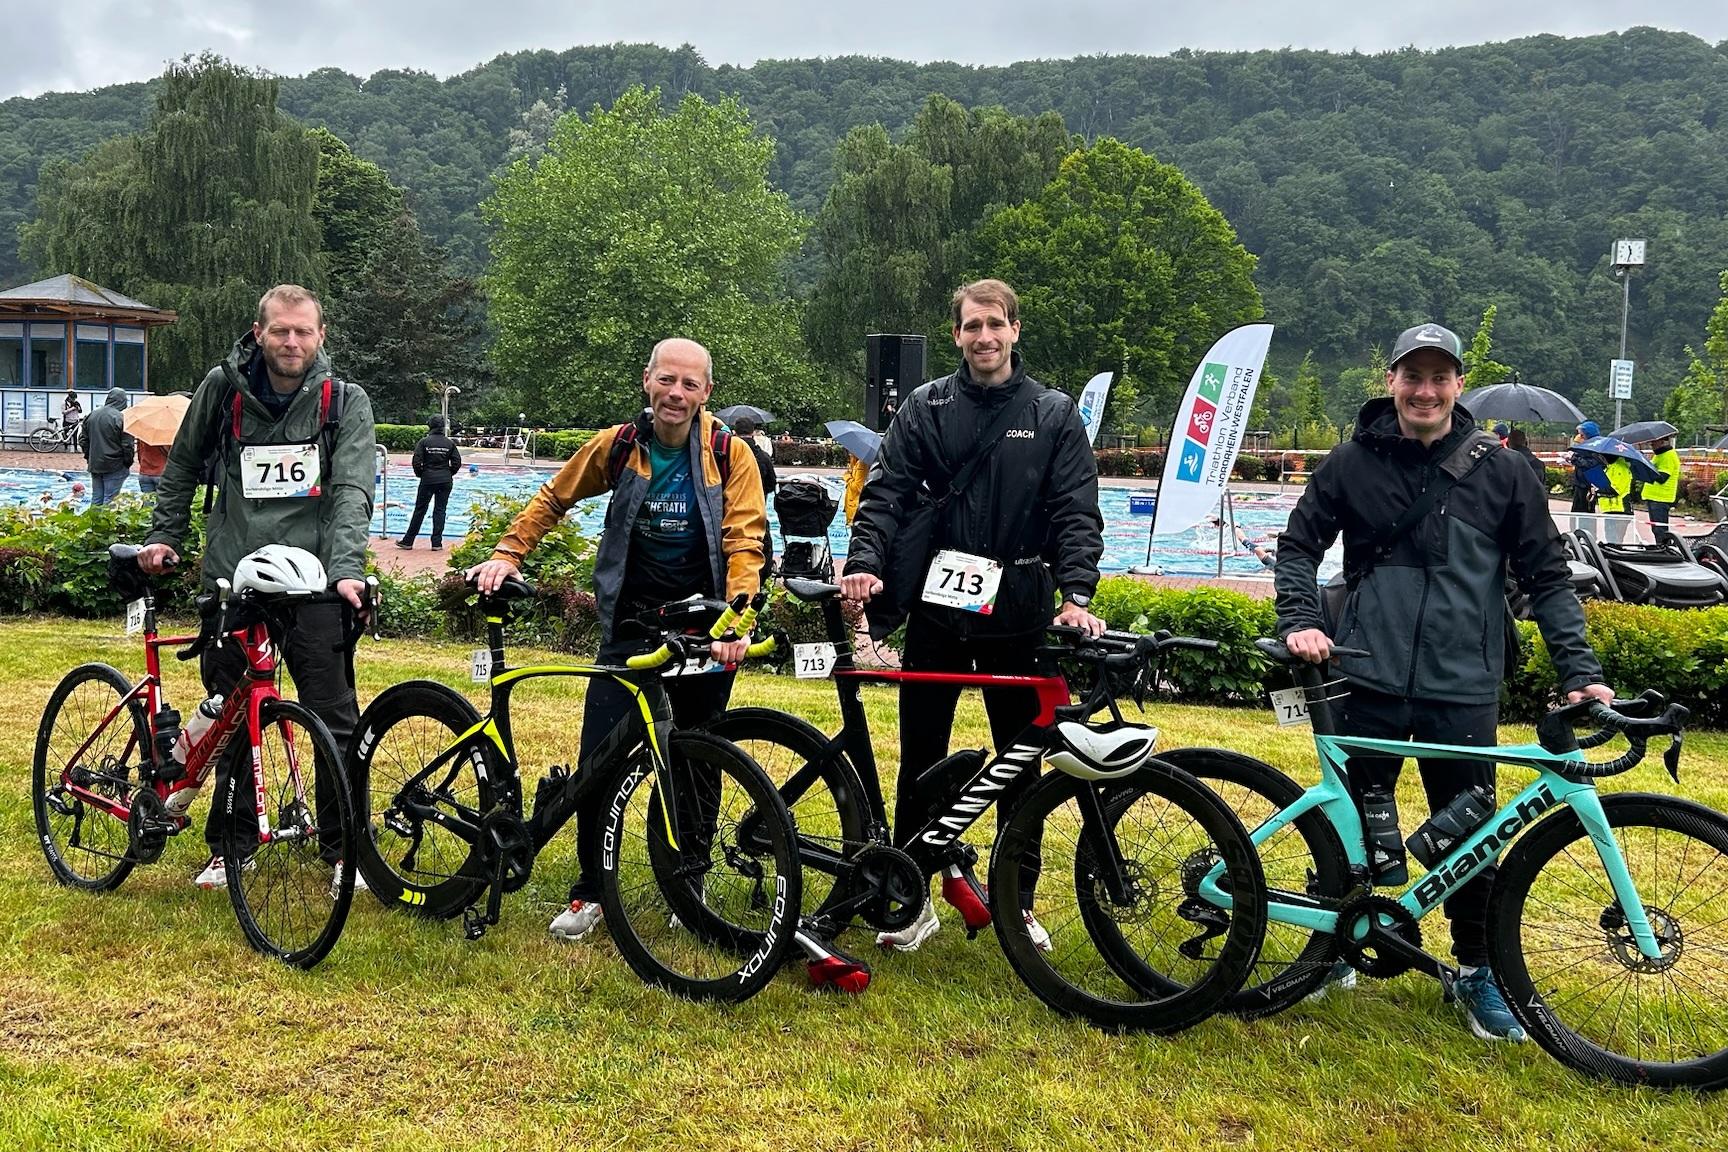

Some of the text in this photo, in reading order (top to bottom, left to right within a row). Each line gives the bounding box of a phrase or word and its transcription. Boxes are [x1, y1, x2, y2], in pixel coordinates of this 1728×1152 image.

[1005, 429, 1035, 439] COACH
[1205, 366, 1243, 486] Triathlon Verband
[1217, 367, 1254, 488] NORDRHEIN-WESTFALEN
[256, 461, 306, 483] 716
[939, 567, 984, 596] 713
[130, 612, 141, 628] 716
[475, 664, 487, 676] 715
[802, 658, 825, 671] 713
[226, 791, 235, 815] SWISS
[252, 745, 267, 816] SIMPLON
[921, 743, 1045, 846] CANYON
[603, 764, 644, 871] EQUINOX
[1412, 782, 1559, 909] Bianchi
[737, 875, 787, 984] EQUINOX
